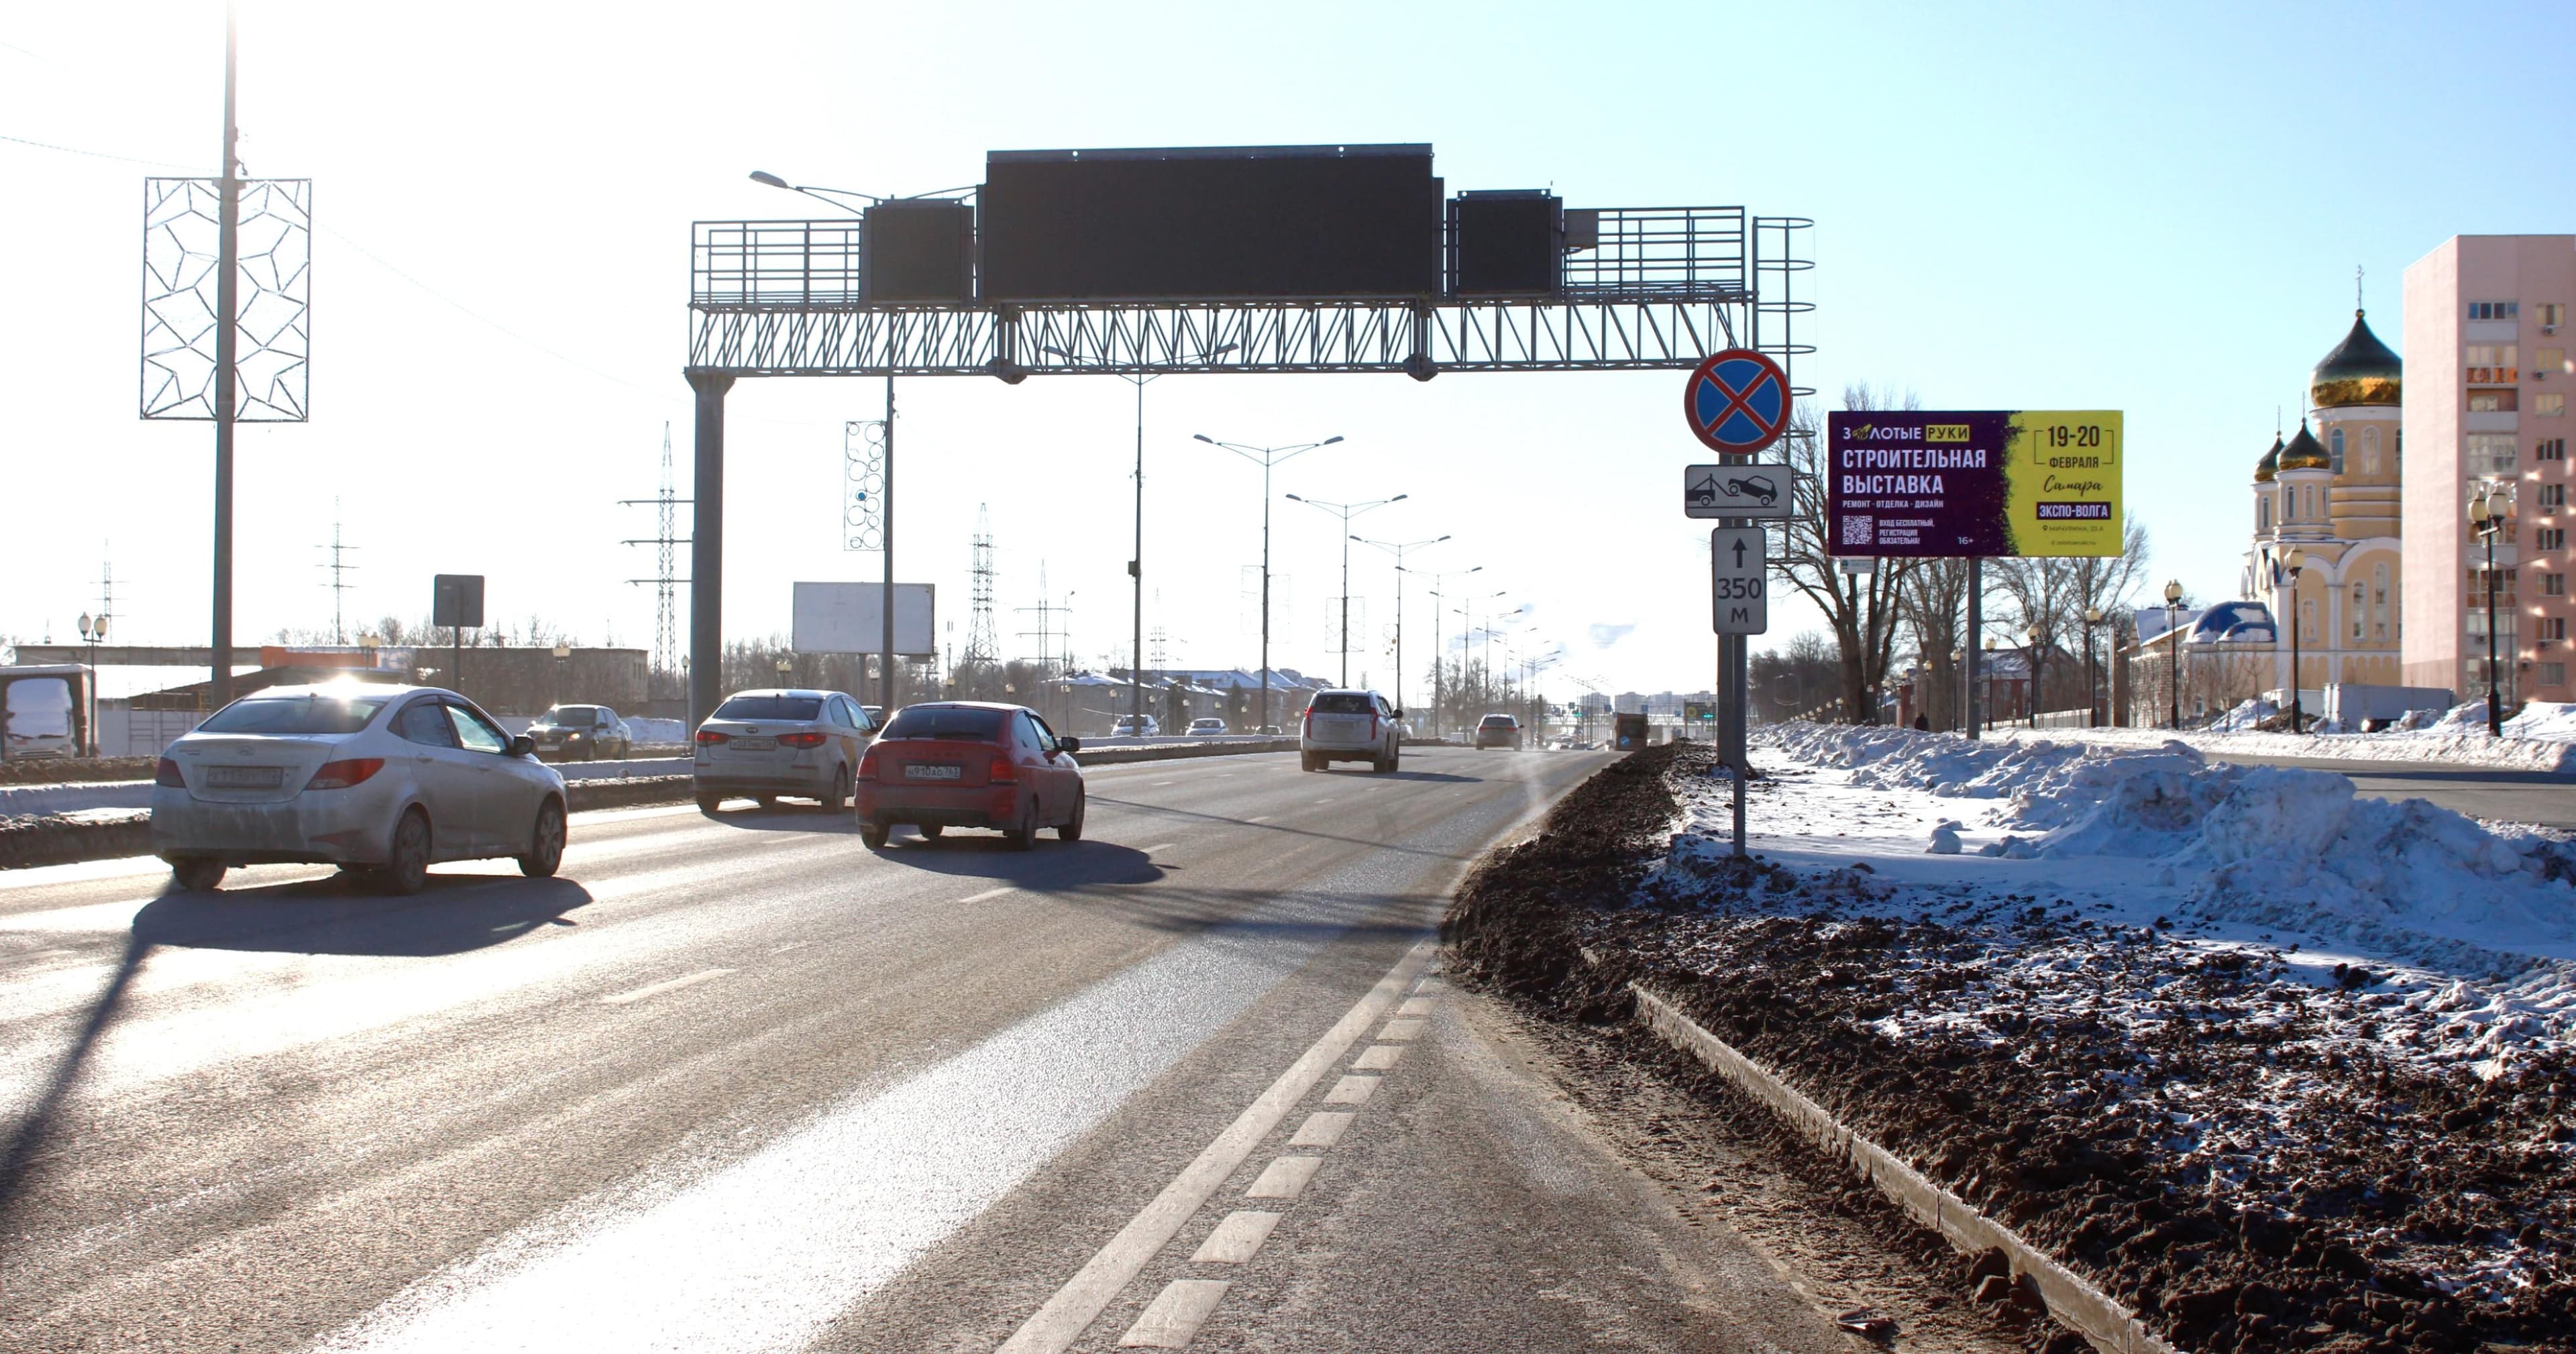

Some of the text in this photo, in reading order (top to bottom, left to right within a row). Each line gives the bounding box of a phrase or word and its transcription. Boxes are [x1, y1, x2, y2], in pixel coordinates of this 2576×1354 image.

[1843, 425, 1968, 440] ЗЛОТЫЕ РУКИ
[2048, 425, 2100, 447] 19-20
[1843, 449, 1986, 468] СТРОИТЕЛЬНАЯ
[2049, 457, 2098, 468] ФЕВРАЛЯ
[1843, 475, 1944, 494] ВЫСТАВКА
[2043, 474, 2104, 497] Самара
[1843, 499, 1944, 509] РЕМОНТ ОТДЕЛКА ДИЗАЙН
[2039, 505, 2108, 517] ЭКСПО-ВОЛГА
[1895, 518, 1935, 527] БЕСПЛАТНЫЙ,
[1717, 578, 1762, 600] 350
